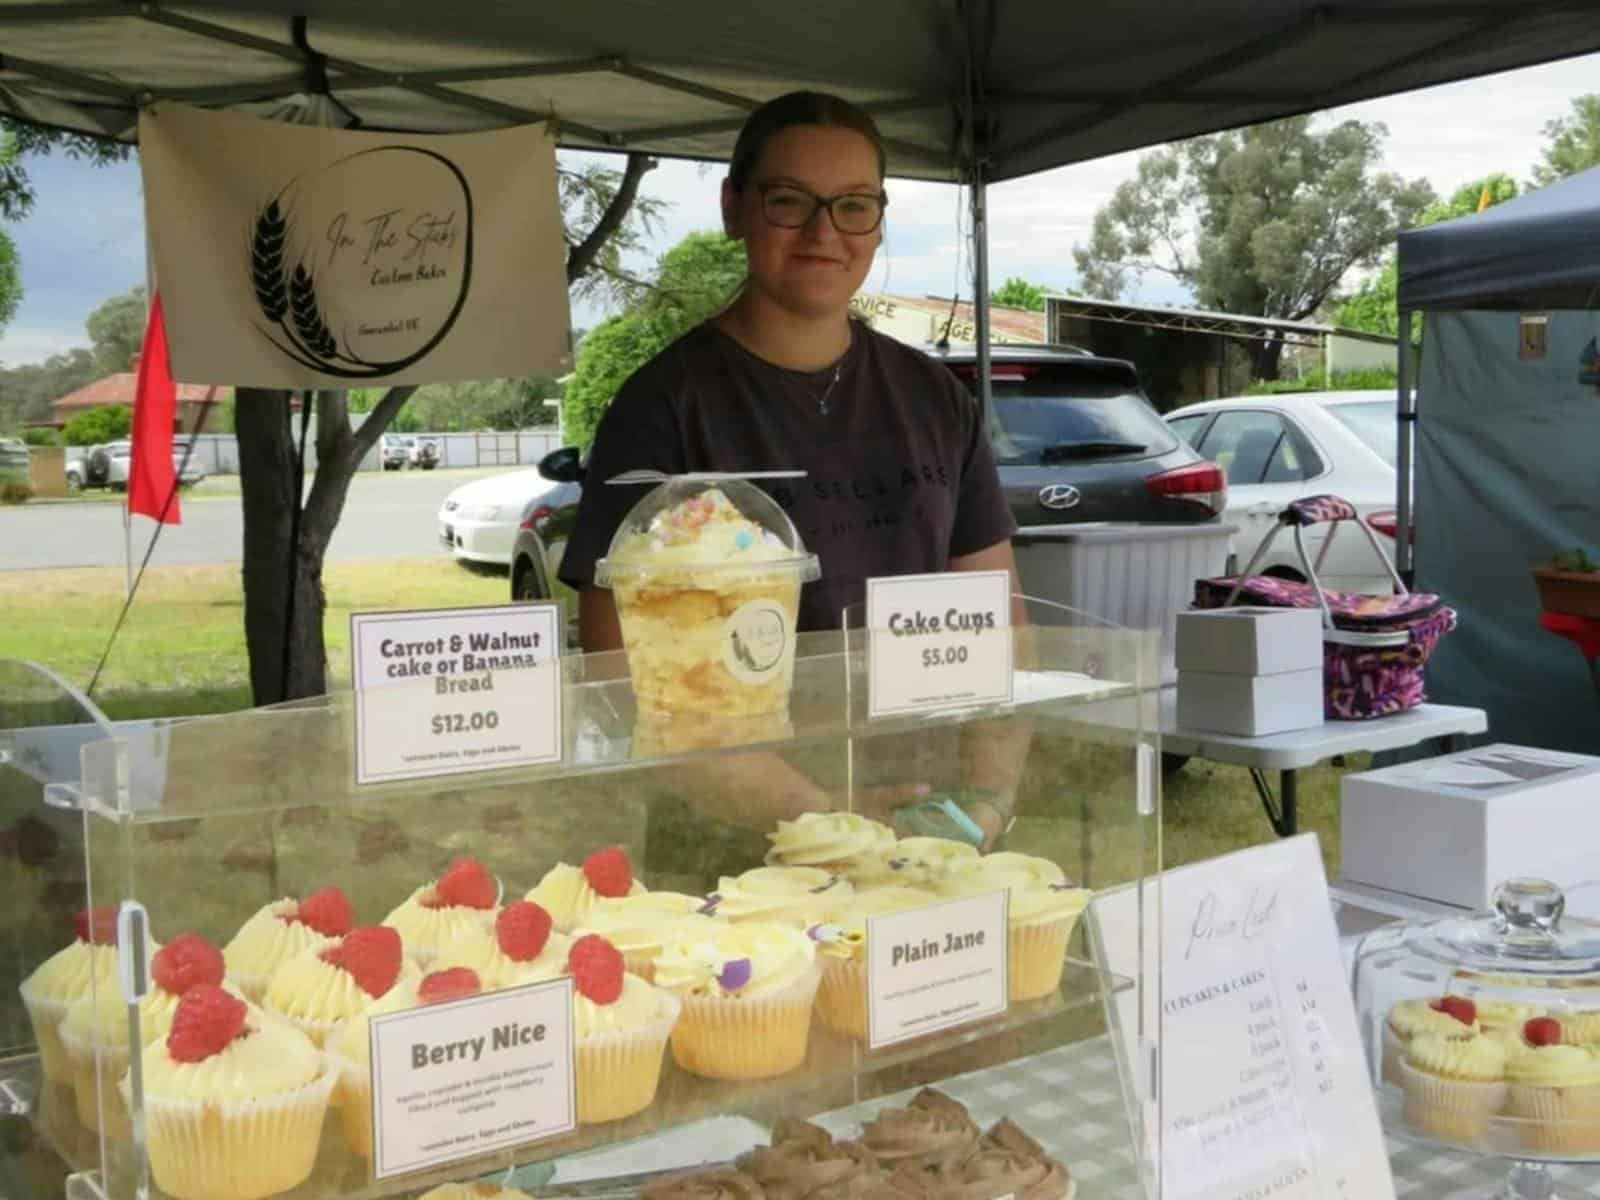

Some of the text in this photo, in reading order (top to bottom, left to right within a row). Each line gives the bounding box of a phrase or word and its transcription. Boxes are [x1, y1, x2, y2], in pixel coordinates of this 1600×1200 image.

[361, 207, 403, 265] The
[888, 607, 996, 637] Cake Cups
[380, 631, 541, 658] Carrot & Walnut
[921, 645, 969, 668] $5.00
[387, 653, 538, 678] cake or Banana
[435, 672, 494, 695] Bread
[431, 710, 499, 734] $12.00
[891, 930, 986, 967] Plain Jane
[410, 1022, 547, 1069] Berry Nice
